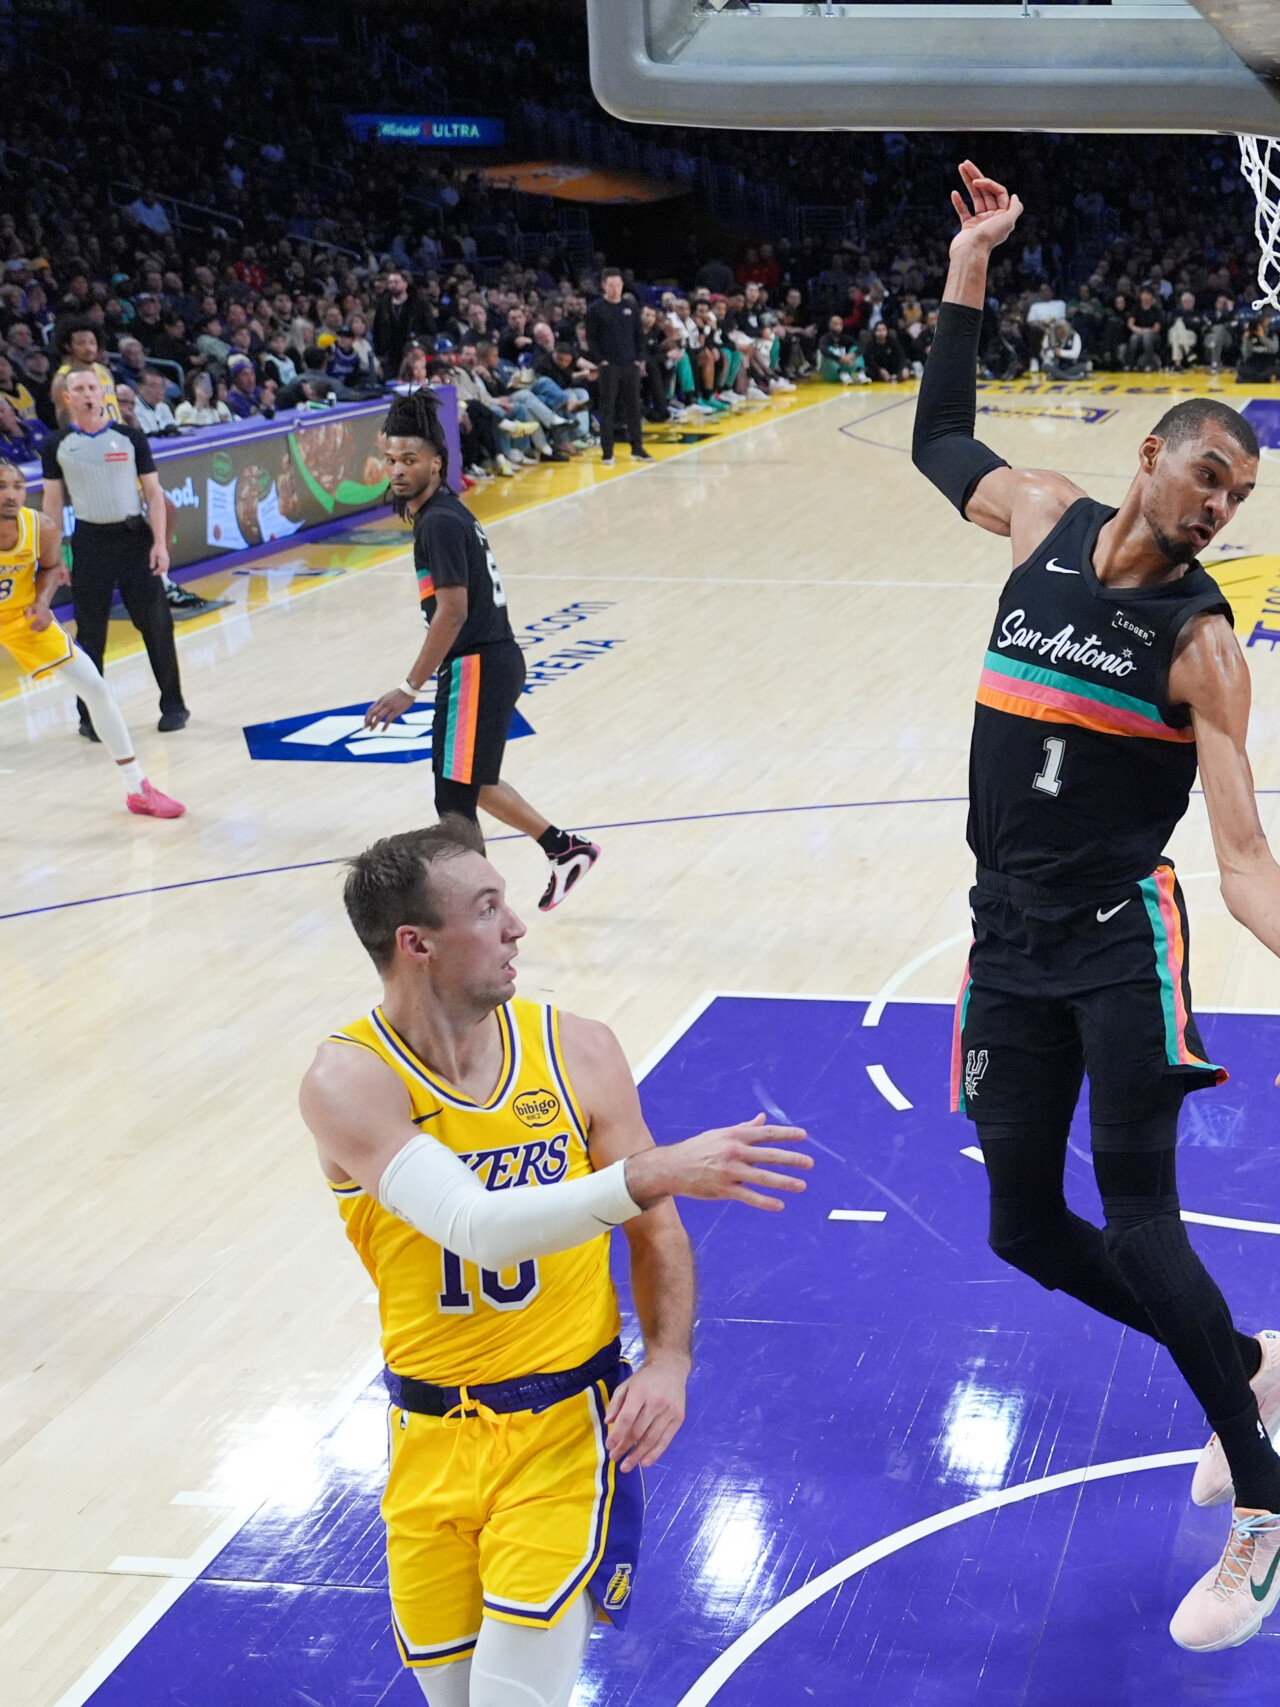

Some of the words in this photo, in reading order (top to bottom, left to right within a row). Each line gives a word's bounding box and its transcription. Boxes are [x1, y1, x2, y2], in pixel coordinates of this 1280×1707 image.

[432, 123, 480, 138] ULTRA
[997, 609, 1042, 649] San
[1041, 624, 1137, 677] Antonio
[1118, 618, 1149, 640] LEDGER
[521, 639, 627, 695] ARENA
[1032, 736, 1066, 797] 1
[515, 1099, 556, 1116] bibigo
[456, 1132, 572, 1192] ERS
